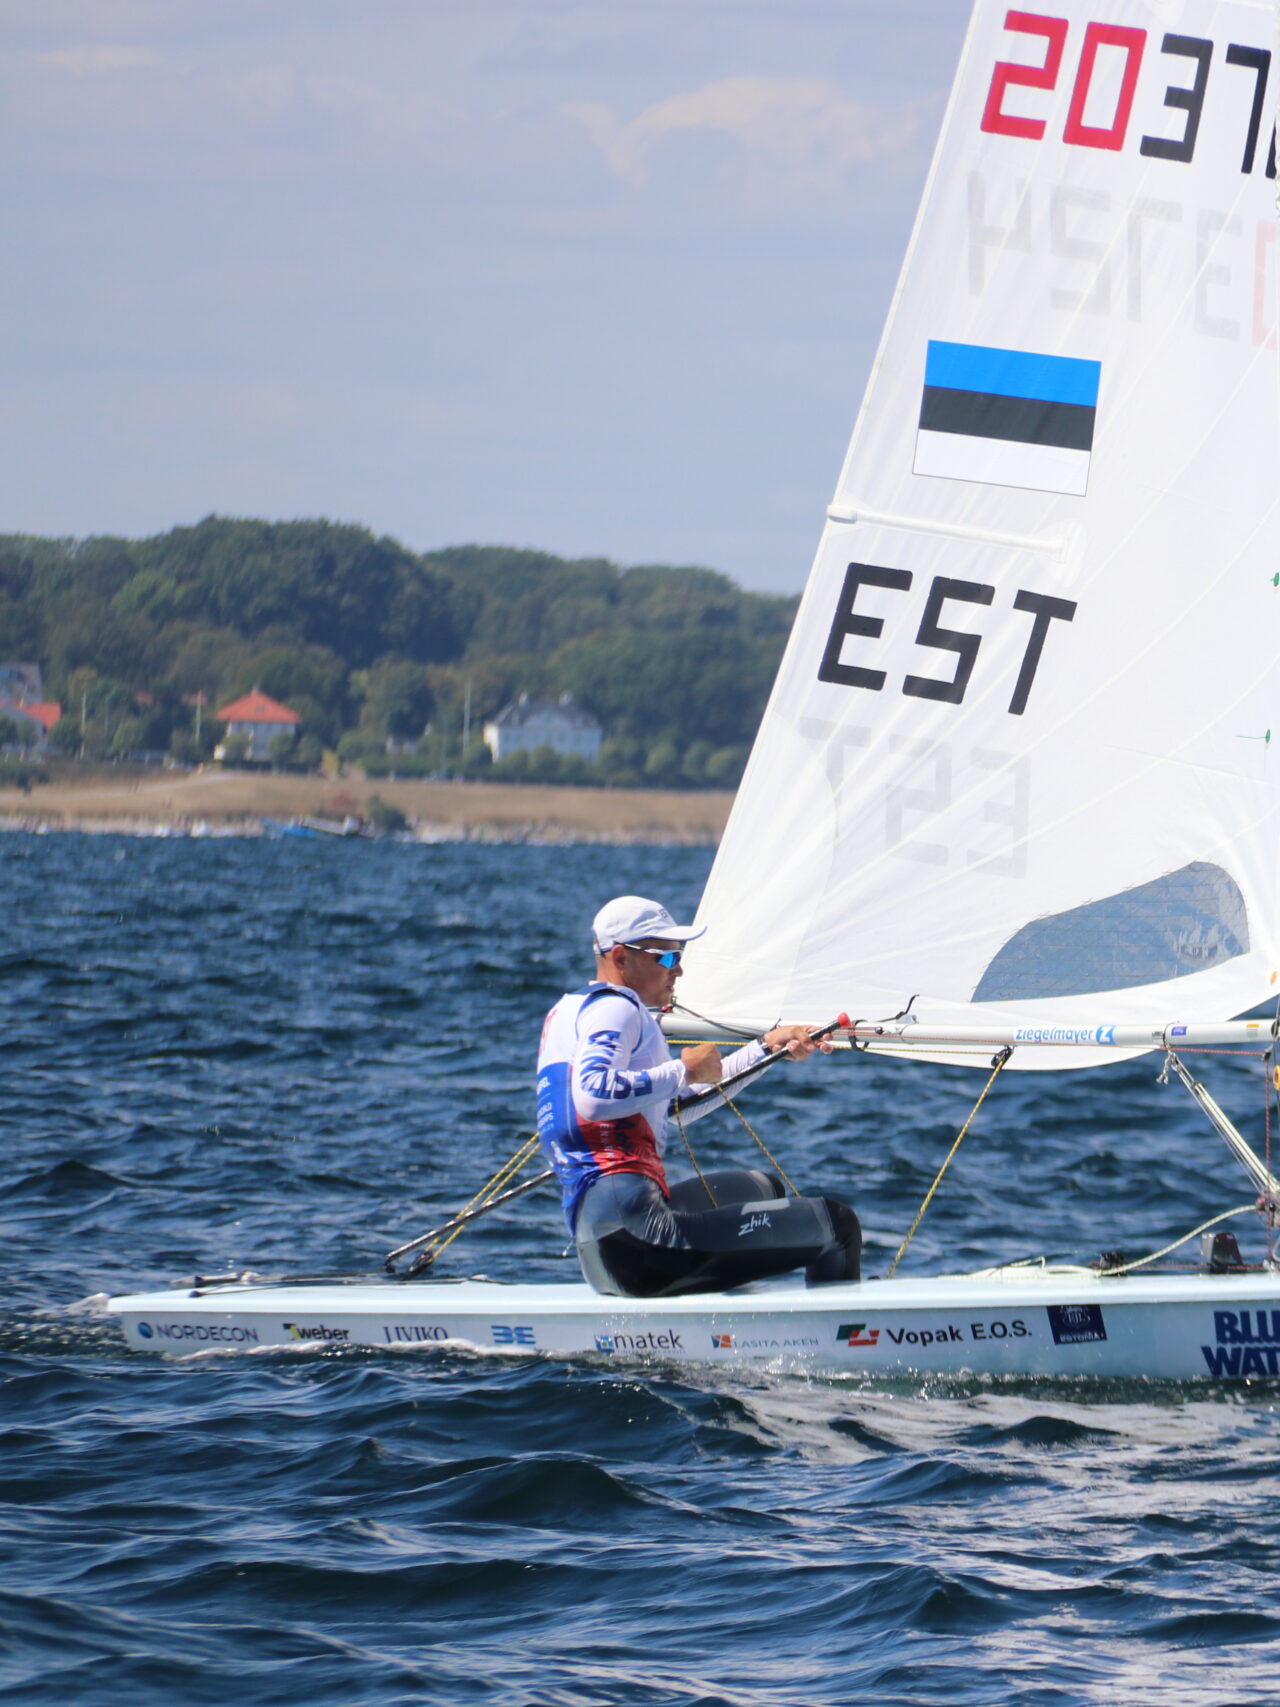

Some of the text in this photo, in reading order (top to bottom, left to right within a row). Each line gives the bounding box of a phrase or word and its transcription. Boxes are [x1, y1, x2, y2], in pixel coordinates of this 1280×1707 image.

[980, 9, 1278, 180] 2037
[818, 562, 1078, 716] EST
[1015, 1026, 1094, 1044] ziegelmayer
[156, 1324, 259, 1342] NORDECON
[298, 1324, 349, 1341] weber
[614, 1328, 685, 1349] matek
[886, 1319, 1032, 1347] Vopak E.O.S.
